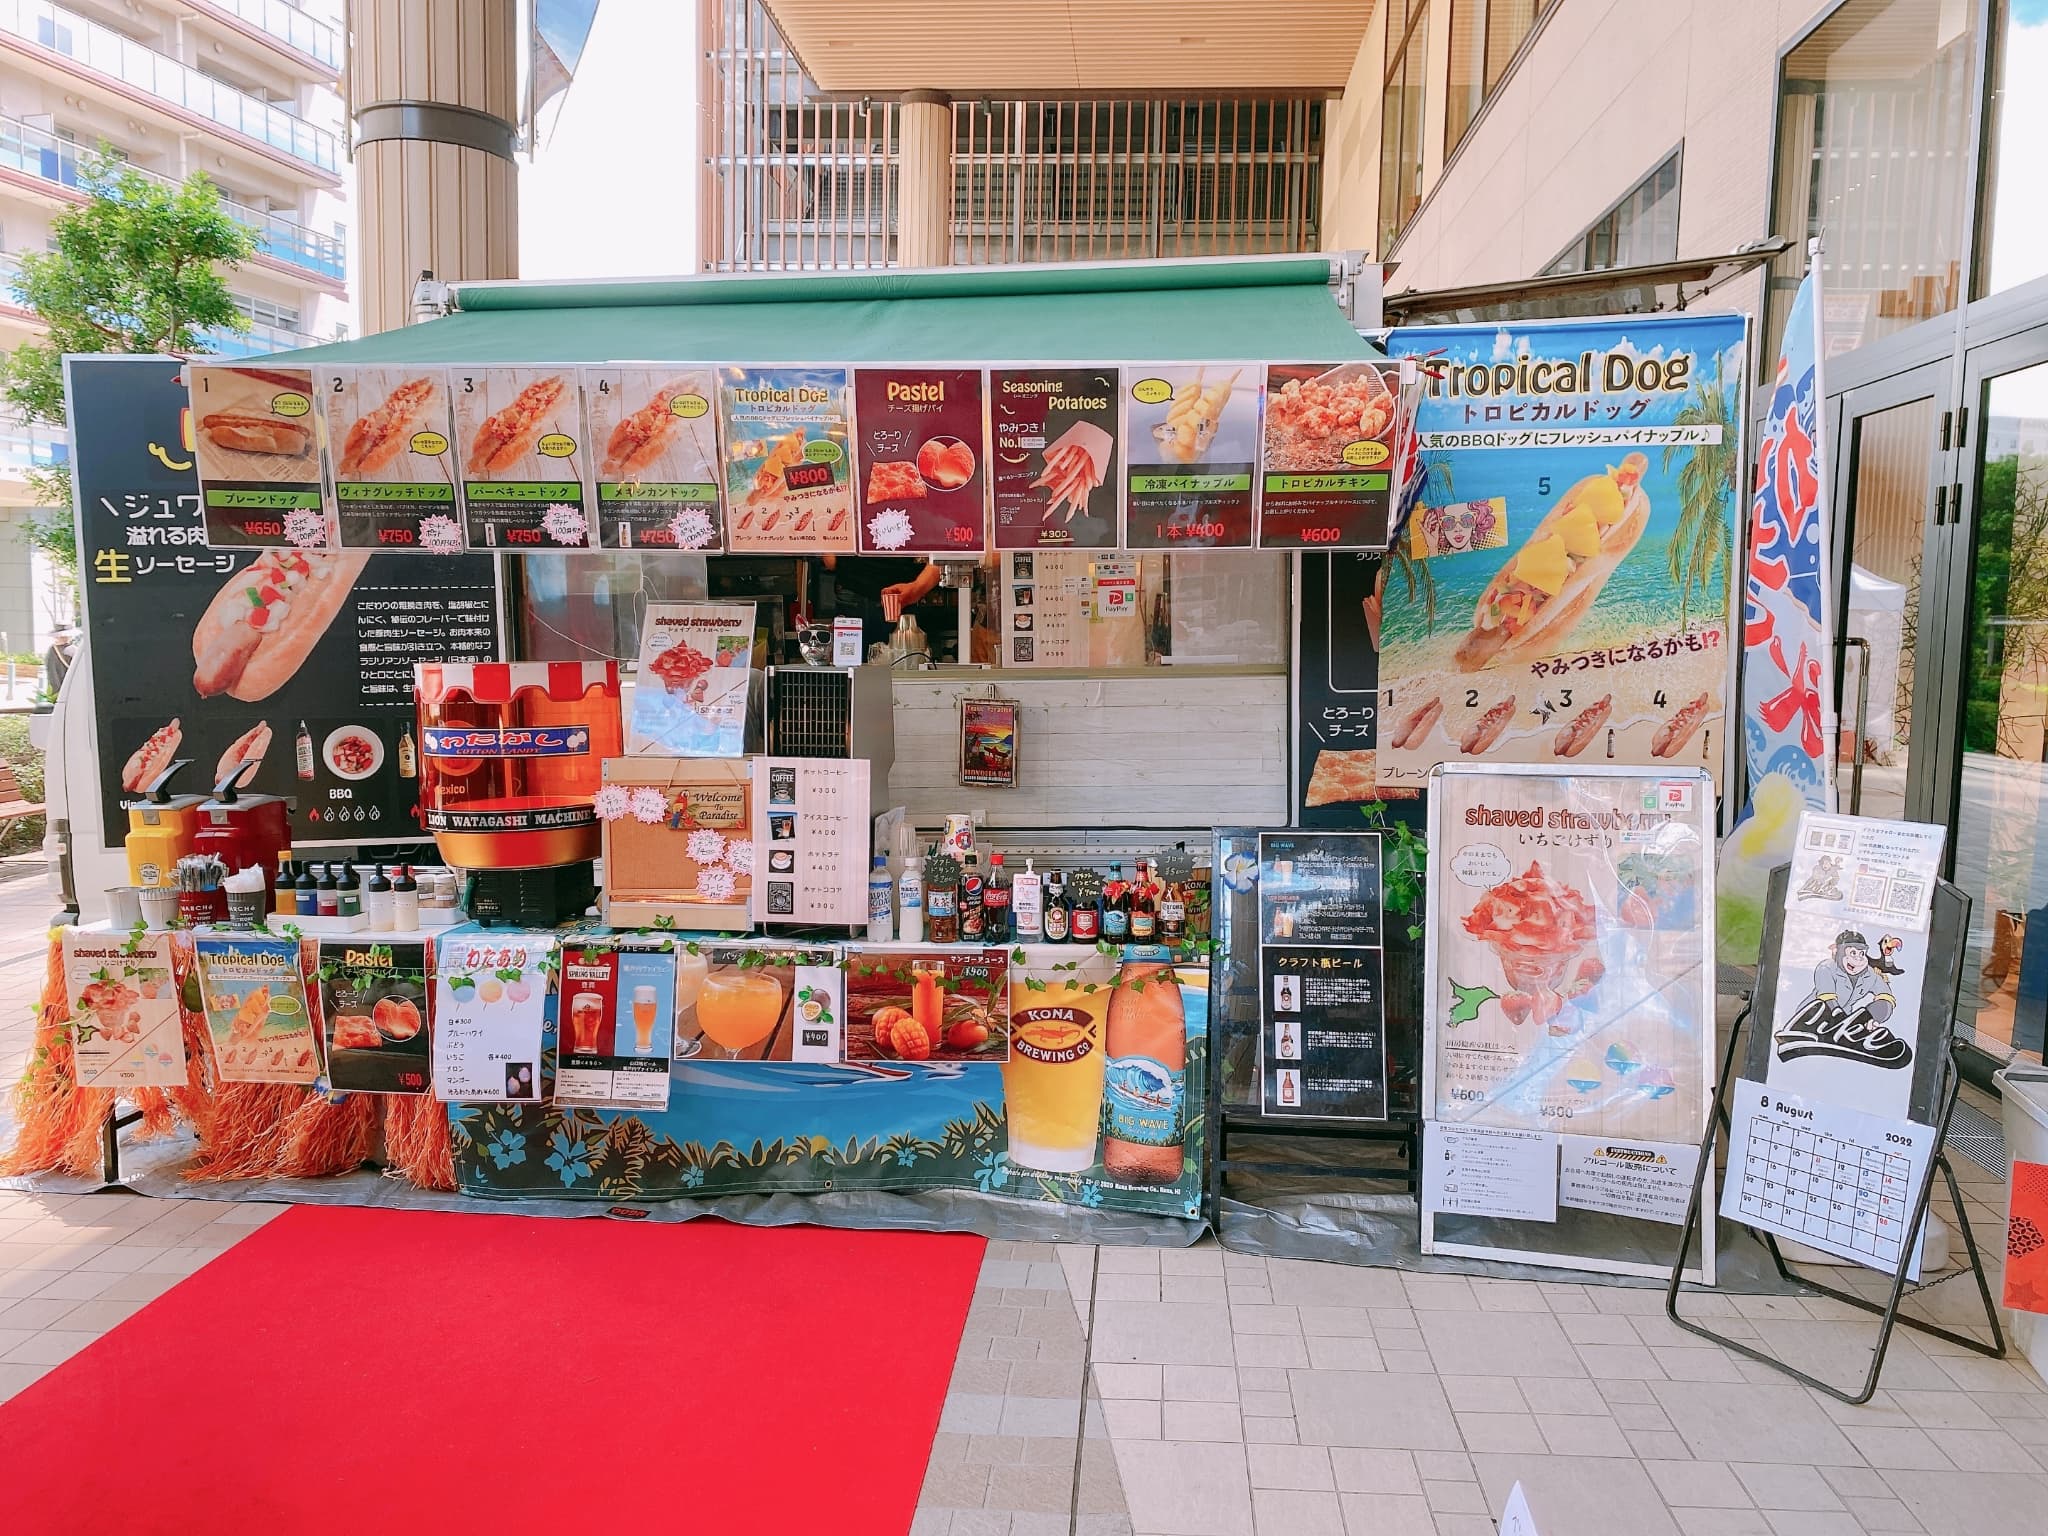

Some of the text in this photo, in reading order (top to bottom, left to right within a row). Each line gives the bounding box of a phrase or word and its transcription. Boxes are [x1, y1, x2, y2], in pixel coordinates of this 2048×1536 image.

[1426, 352, 1690, 398] Tropical Dog
[203, 378, 209, 392] 1
[333, 378, 344, 392] 2
[463, 378, 474, 393] 3
[599, 380, 610, 394] 4
[887, 380, 944, 402] Pastel
[1002, 380, 1063, 393] Seasoning
[735, 387, 828, 403] Tropical Dog
[750, 404, 816, 412] トロピカルドッグ
[1048, 396, 1107, 410] Potatoes
[1464, 398, 1651, 424] トロピカルドッグ
[873, 430, 902, 440] とろーり
[876, 443, 899, 453] チーズ
[790, 468, 828, 485] ¥800
[1282, 478, 1370, 489] トロピカルチキン
[1144, 478, 1235, 490] 冷凍パイナップル
[1538, 476, 1550, 497] 5
[244, 521, 280, 536] ¥650
[944, 527, 974, 542] ¥500
[1041, 530, 1068, 538] ¥300
[1186, 522, 1224, 538] ¥400
[1300, 528, 1340, 542] ¥600
[378, 530, 413, 543] ¥750
[506, 530, 542, 543] ¥750
[655, 616, 742, 628] shaved strawberry
[1382, 689, 1667, 708] 1 2 3 4
[1322, 706, 1374, 720] とろーり
[1328, 724, 1368, 736] チーズ
[440, 731, 564, 750] わたがし
[772, 774, 794, 782] COFFEE
[329, 788, 352, 800] BBQ
[695, 792, 742, 802] Welcome
[428, 808, 590, 828] LION WATAGASHI MACHINE
[700, 811, 738, 820] Paradise
[1464, 804, 1544, 829] shaved
[1519, 832, 1612, 848] いちごけずり
[1184, 882, 1206, 890] KONA
[74, 948, 106, 958] shaved
[466, 948, 527, 968] わたあめ
[950, 954, 1004, 964] マンゴージュース
[210, 954, 285, 967] Tropical Dog
[1278, 957, 1363, 969] クラフト瓶ビール
[568, 970, 609, 979] SPRING VALLEY
[335, 990, 358, 998] とろーり
[338, 1000, 358, 1008] チーズ
[1027, 1008, 1074, 1022] KONA
[1776, 999, 1896, 1054] Like
[1016, 1042, 1075, 1063] BREWING
[398, 1072, 422, 1086] ¥500
[1450, 1088, 1484, 1101] ¥600
[1540, 1106, 1574, 1119] ¥300
[1760, 1096, 1814, 1120] 8 August
[1118, 1114, 1169, 1130] BIG WAVE
[1885, 1132, 1913, 1148] 2022
[1583, 1156, 1678, 1176] アルコール販売について
